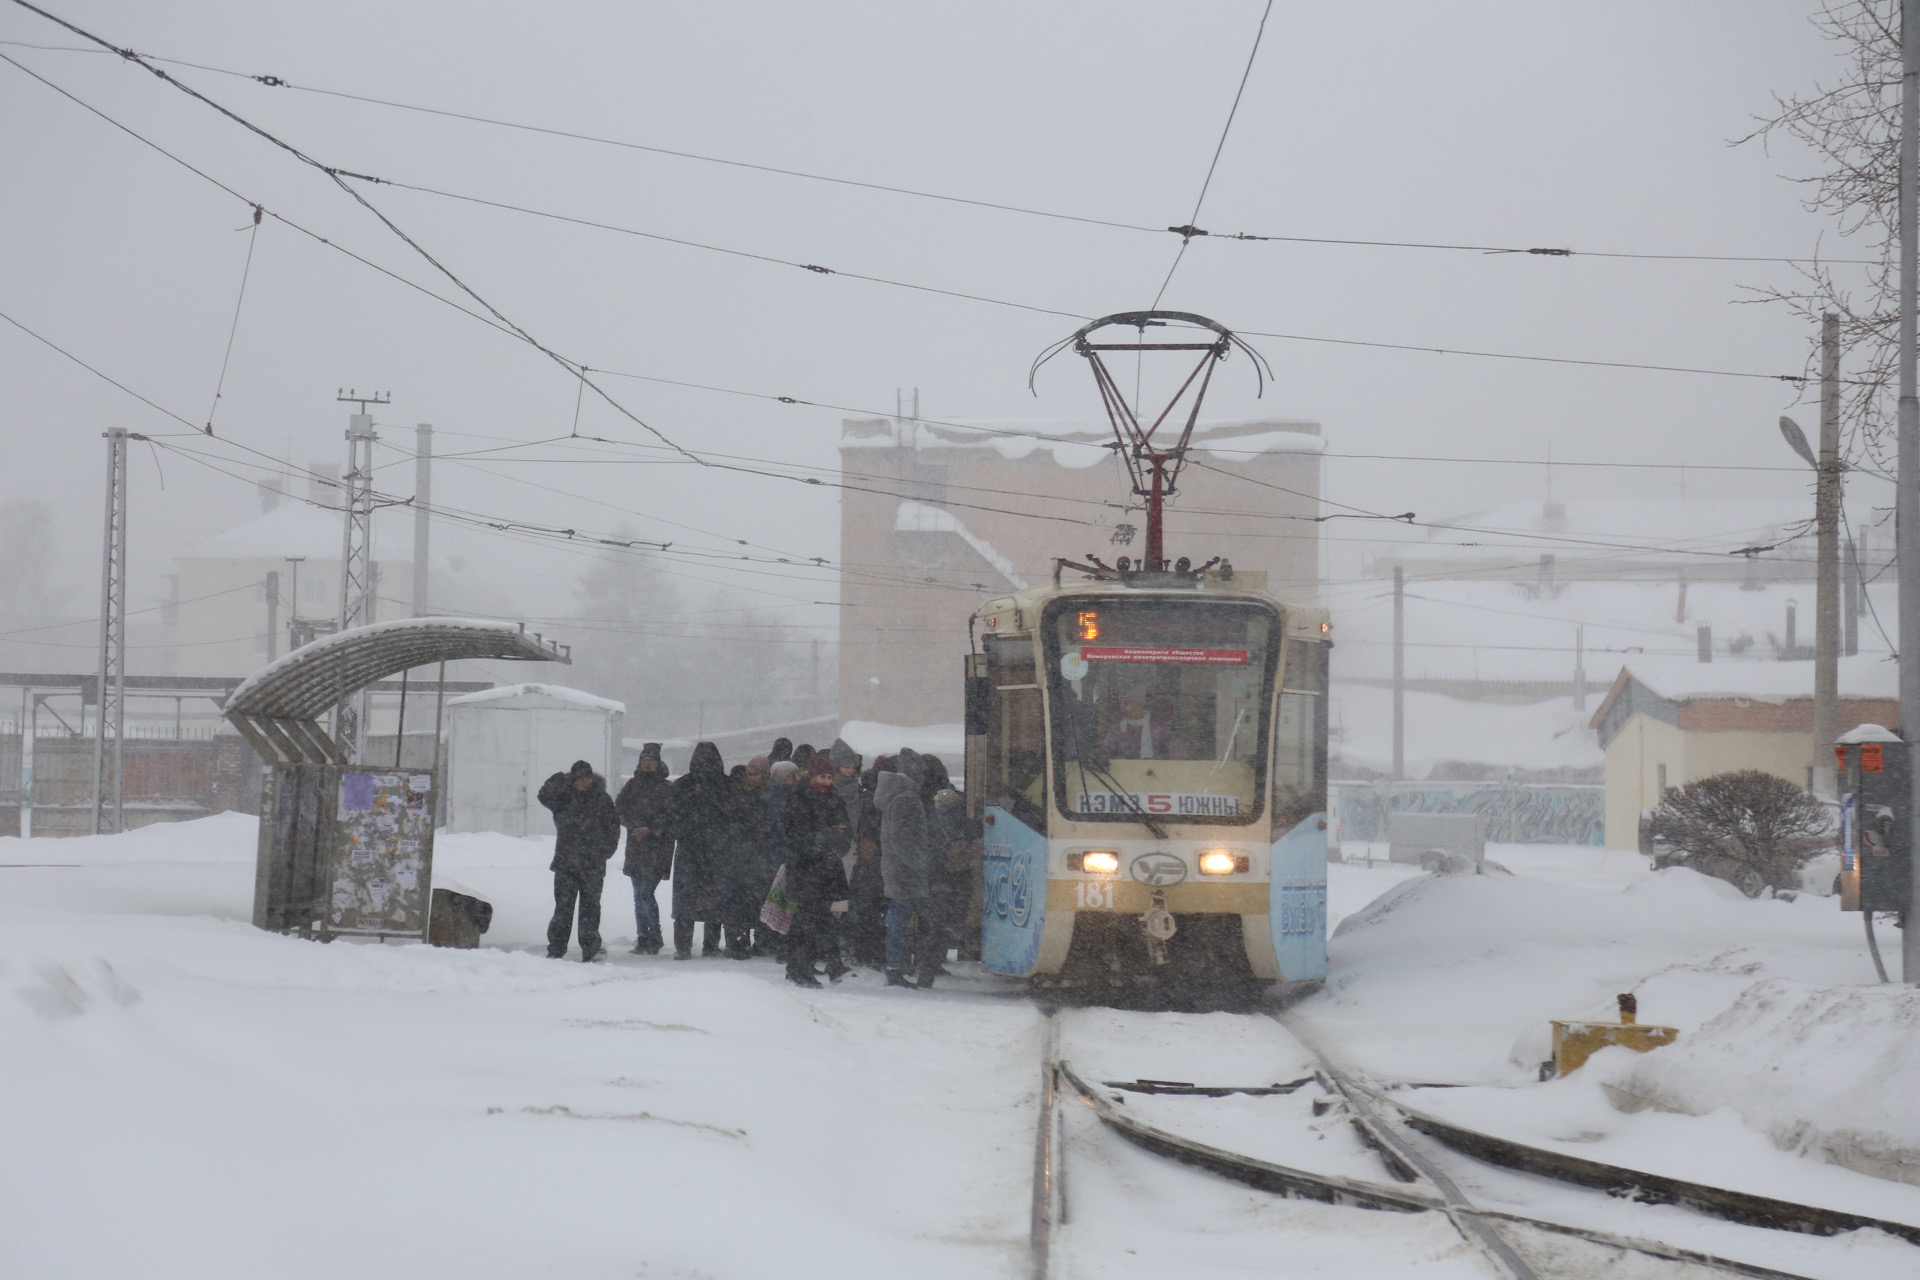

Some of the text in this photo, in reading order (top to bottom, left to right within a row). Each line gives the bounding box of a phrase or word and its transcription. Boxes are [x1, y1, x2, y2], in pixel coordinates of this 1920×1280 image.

[1079, 612, 1097, 640] 5
[1148, 795, 1171, 812] 5
[1074, 882, 1114, 908] 181
